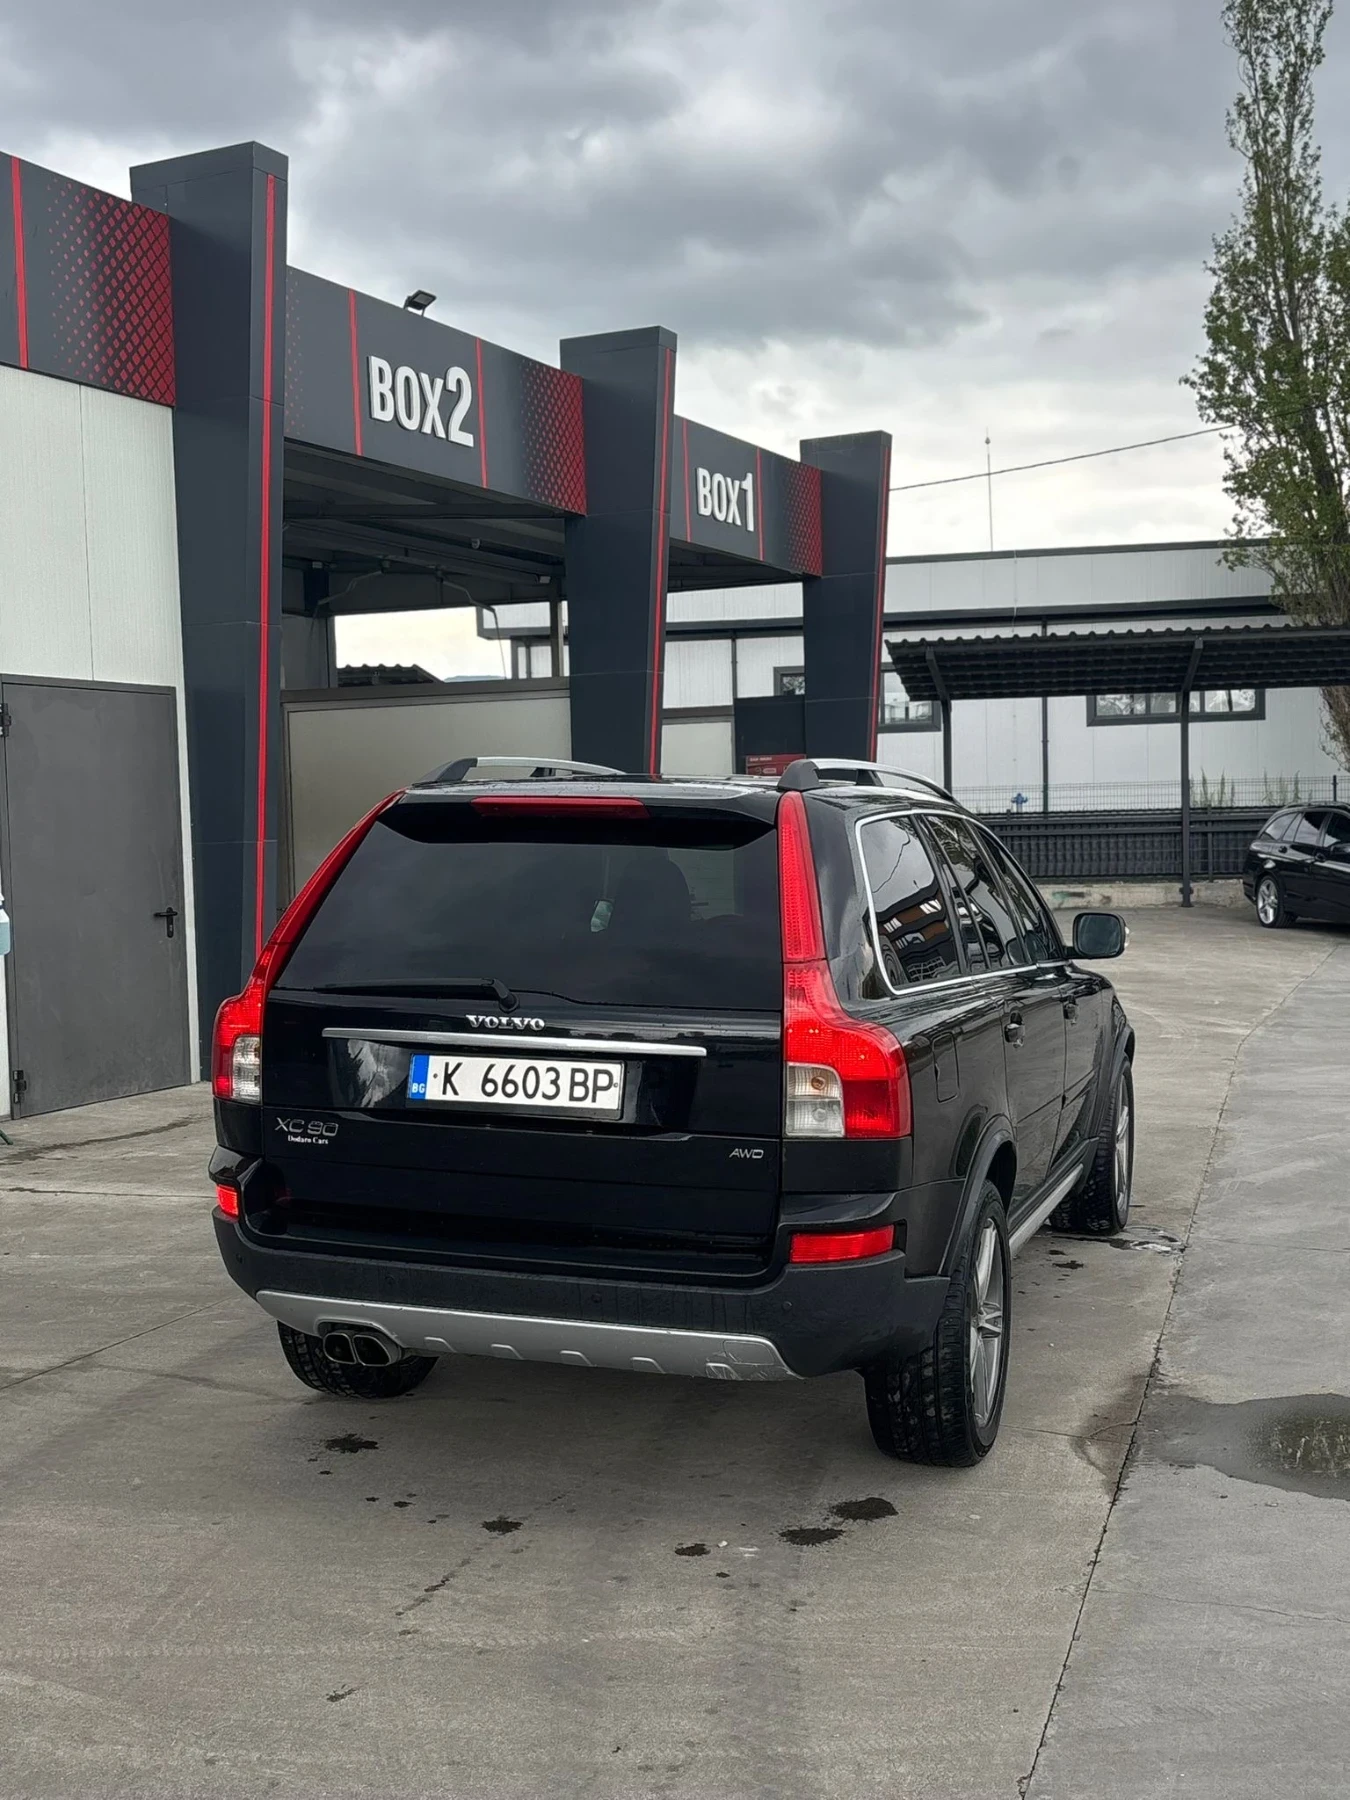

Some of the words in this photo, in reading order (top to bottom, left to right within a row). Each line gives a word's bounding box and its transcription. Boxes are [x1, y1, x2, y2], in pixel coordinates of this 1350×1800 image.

[465, 1014, 545, 1031] VOLVO
[411, 1082, 425, 1093] BG
[442, 1062, 463, 1096] K
[481, 1064, 560, 1100] 6603
[569, 1067, 613, 1103] BP
[313, 1136, 329, 1146] Cars
[729, 1148, 764, 1159] AWD
